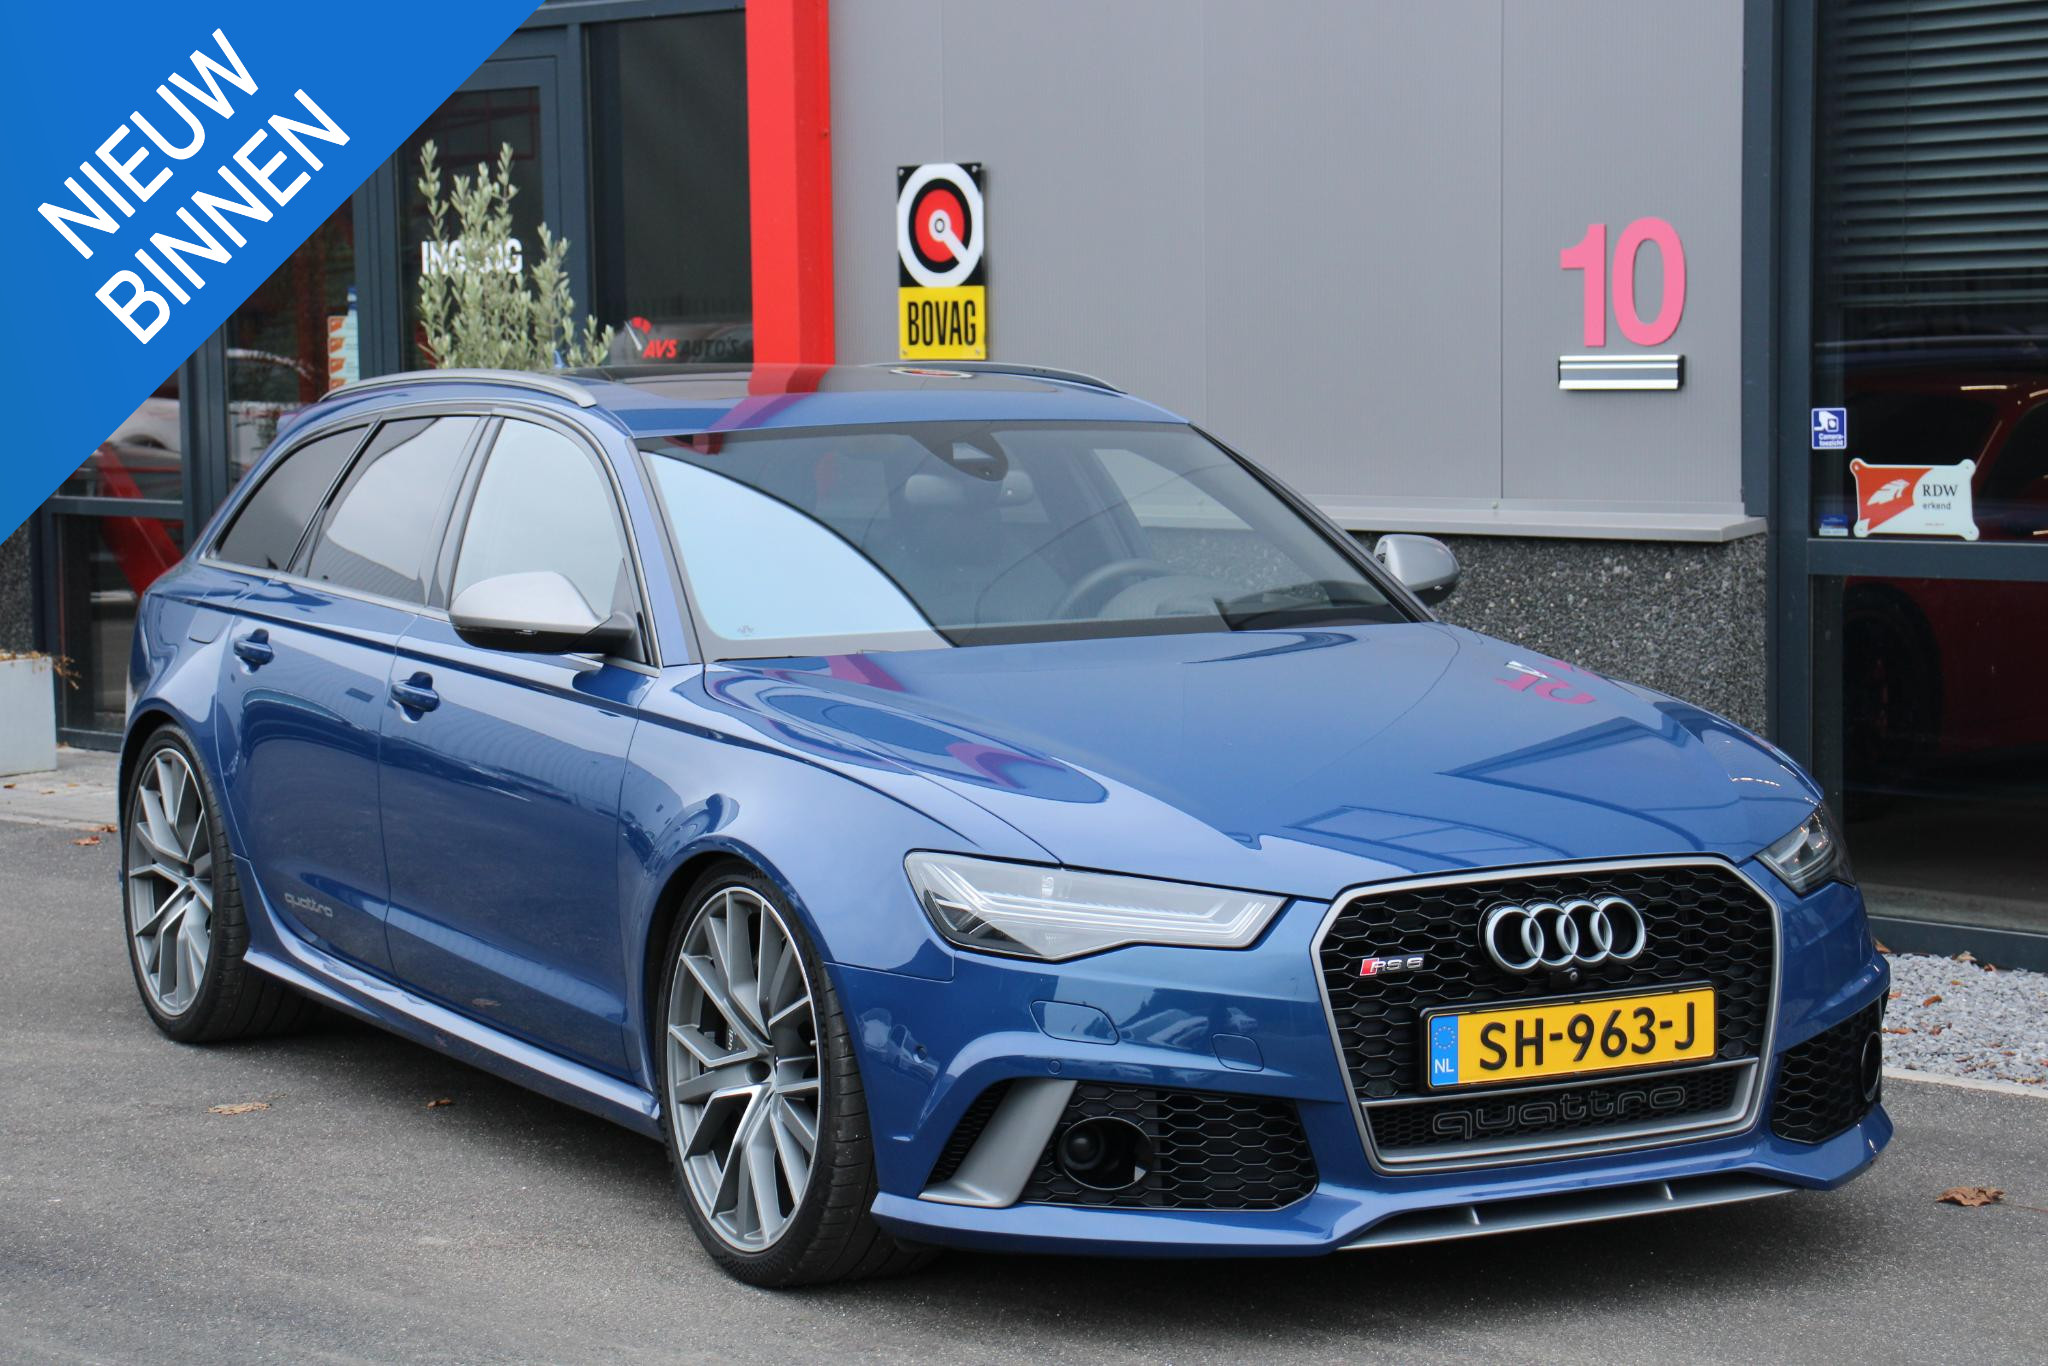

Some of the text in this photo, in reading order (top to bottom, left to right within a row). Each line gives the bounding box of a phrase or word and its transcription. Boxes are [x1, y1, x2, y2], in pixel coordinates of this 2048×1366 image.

[1560, 216, 1687, 348] 10
[908, 300, 976, 346] BOVAG
[642, 338, 678, 359] AVS
[1922, 484, 1958, 497] RDW
[1922, 502, 1951, 510] erkend
[1479, 1001, 1695, 1071] SH-963-J
[1434, 1058, 1455, 1074] NL
[1432, 1085, 1686, 1140] quattro
